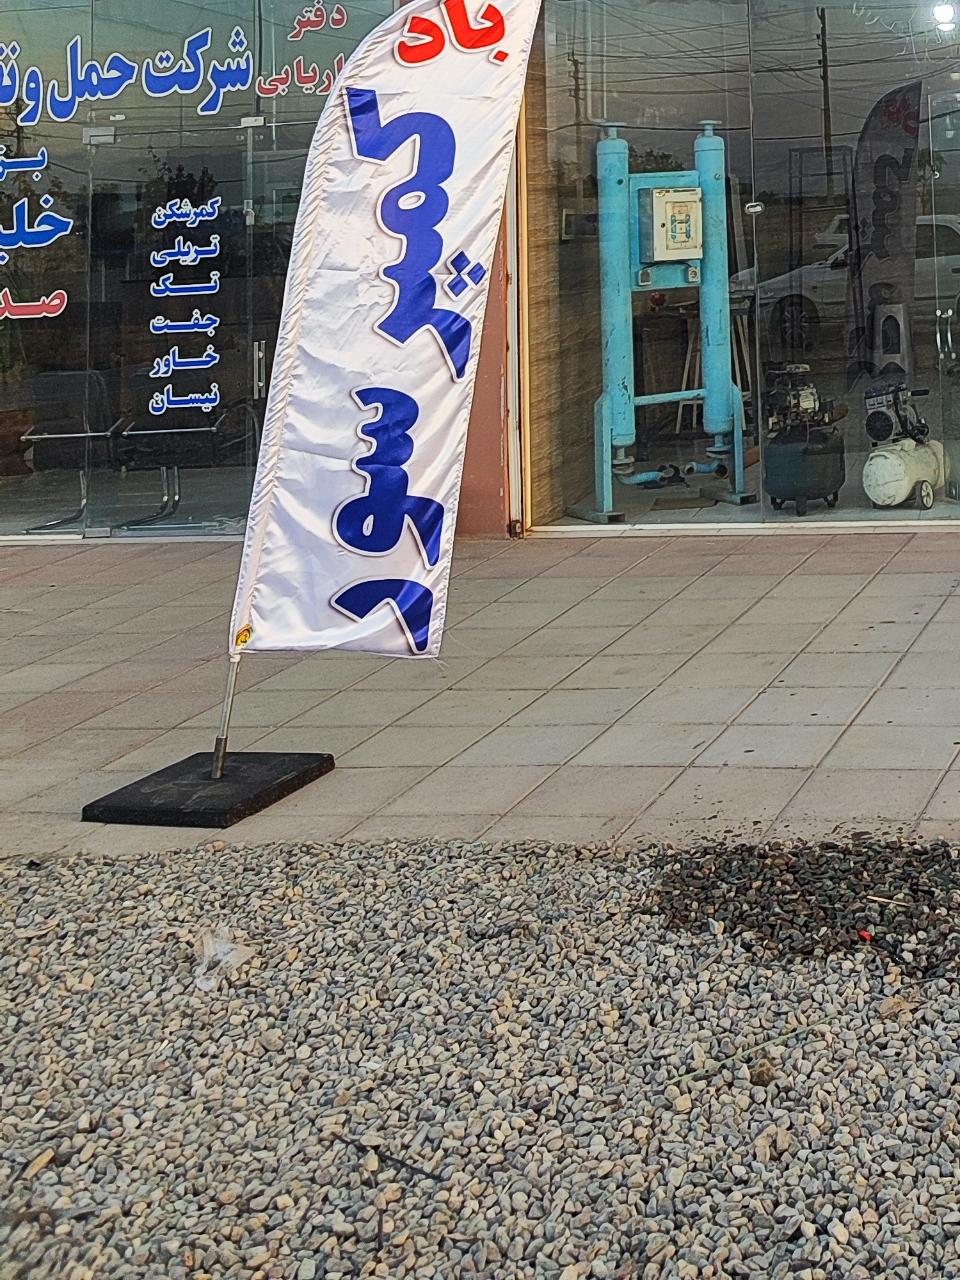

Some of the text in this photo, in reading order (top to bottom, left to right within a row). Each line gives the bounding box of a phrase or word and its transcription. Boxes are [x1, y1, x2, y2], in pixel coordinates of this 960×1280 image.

[46, 34, 138, 122] حمل
[141, 24, 255, 116] شرکت
[151, 196, 222, 229] کمرشکن
[150, 234, 221, 267] تریلی
[150, 270, 220, 297] تک
[150, 308, 220, 337] جفت
[149, 344, 220, 377] خاور
[329, 86, 488, 656] کمپرسور
[149, 383, 220, 415] نیسان
